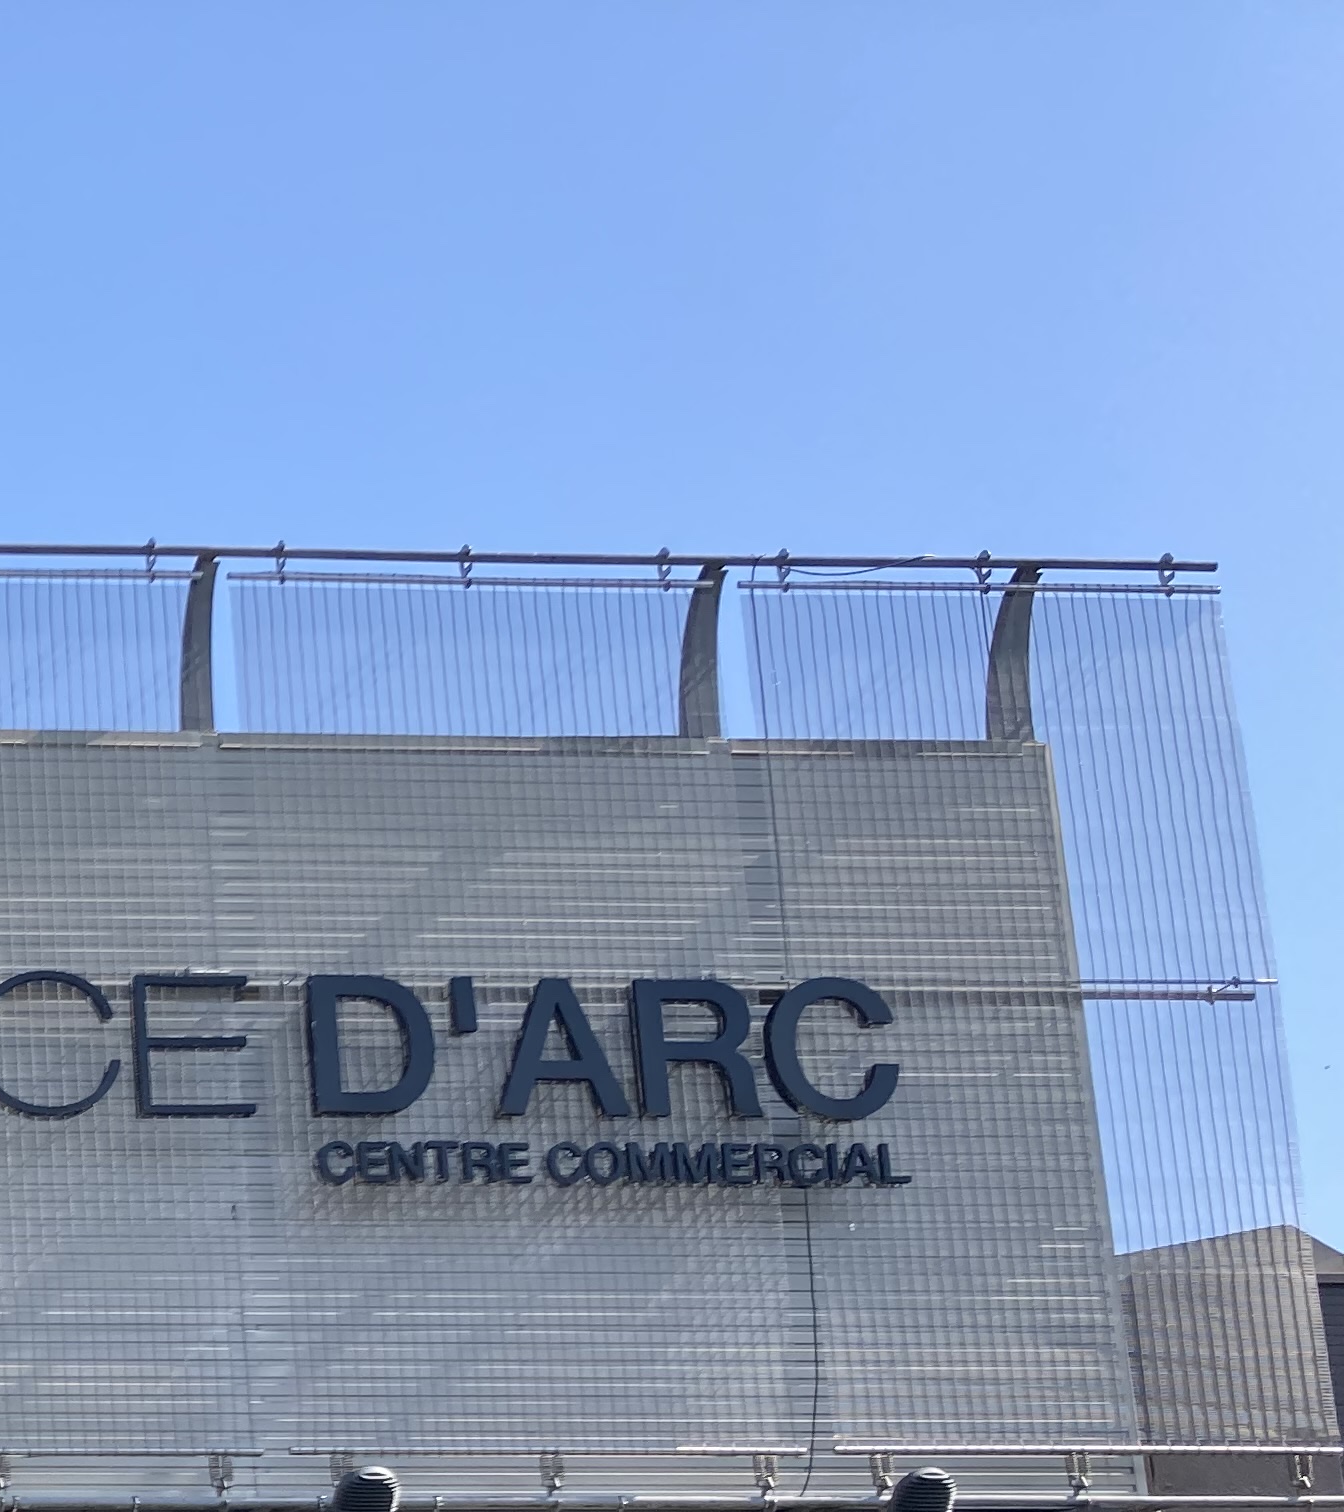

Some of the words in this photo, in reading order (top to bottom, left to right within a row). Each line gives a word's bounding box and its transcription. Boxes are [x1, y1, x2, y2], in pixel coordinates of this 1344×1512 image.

[306, 974, 900, 1123] D'ARC
[316, 1140, 533, 1186] CENTRE
[546, 1141, 912, 1189] COMMERCIAL
